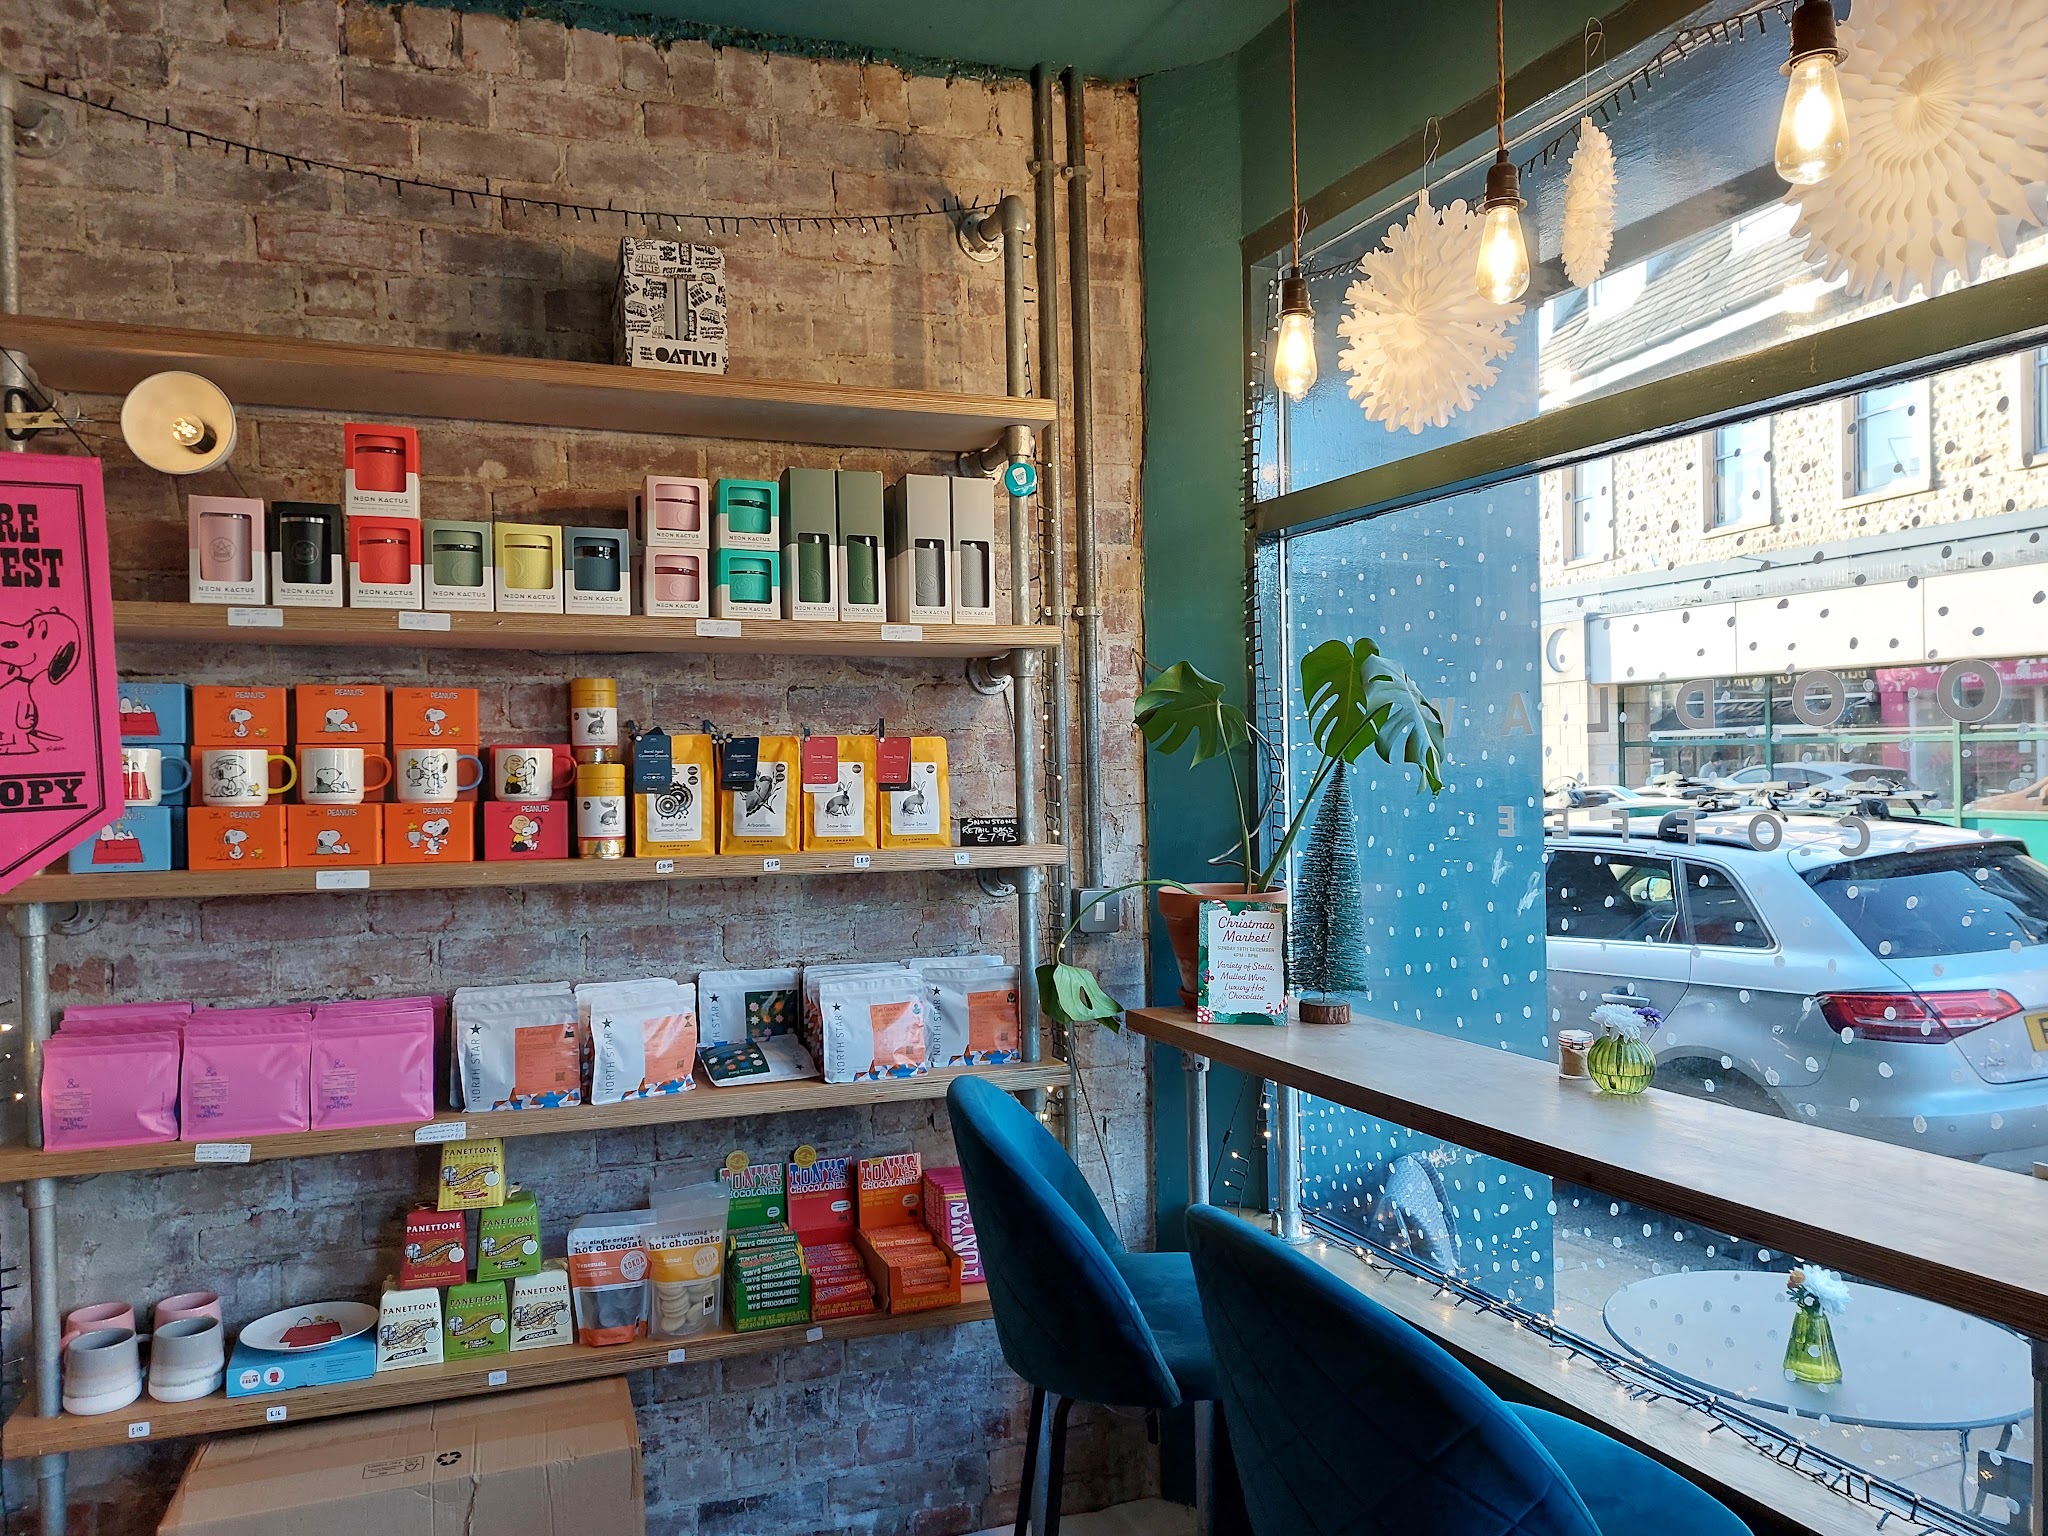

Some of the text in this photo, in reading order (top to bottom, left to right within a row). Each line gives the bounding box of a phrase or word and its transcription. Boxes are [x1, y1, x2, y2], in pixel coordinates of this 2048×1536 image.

[655, 347, 716, 367] OATLY!
[0, 547, 63, 588] EST
[235, 691, 265, 699] PEANUTS
[430, 692, 458, 700] PEANUTS
[0, 778, 82, 807] OPY
[422, 807, 452, 815] PEANUTS
[521, 805, 549, 813] PEANUTS
[962, 826, 990, 834] RETAIL
[1218, 916, 1275, 930] Christmas
[1222, 930, 1271, 943] Market!
[1217, 960, 1275, 972] Variety of Stalls,
[1220, 972, 1268, 982] Mulled Wine,
[1224, 983, 1250, 994] Luxury
[1228, 991, 1264, 1000] Chocolate
[711, 1006, 720, 1029] STAR
[933, 999, 941, 1056] NORTH STAR
[836, 1014, 845, 1074] NORTH STAR
[603, 1032, 614, 1094] NORTH STAR
[472, 1038, 481, 1102] NORTH STAR
[445, 1147, 497, 1155] PANETTONE
[789, 1157, 850, 1186] TONY'S
[860, 1153, 921, 1184] TONY'S
[790, 1181, 849, 1194] CHOCOLONELY
[861, 1177, 920, 1190] CHOCOLONELY
[729, 1186, 783, 1199] HOCOLONELY
[483, 1215, 535, 1227] PANETTONE
[407, 1222, 461, 1233] PANETTONE
[612, 1236, 634, 1244] origin
[661, 1230, 708, 1240] award winning
[574, 1240, 643, 1254] hot chocolat
[650, 1235, 720, 1250] hot chocolate
[576, 1261, 607, 1269] Venezuela
[624, 1258, 645, 1271] KOKOA
[515, 1285, 567, 1296] PANETTONE
[450, 1294, 503, 1306] PANETTONE
[383, 1302, 437, 1315] PANETTONE
[525, 1329, 554, 1340] CHOCOLATE
[392, 1348, 424, 1360] CHOCOLATE
